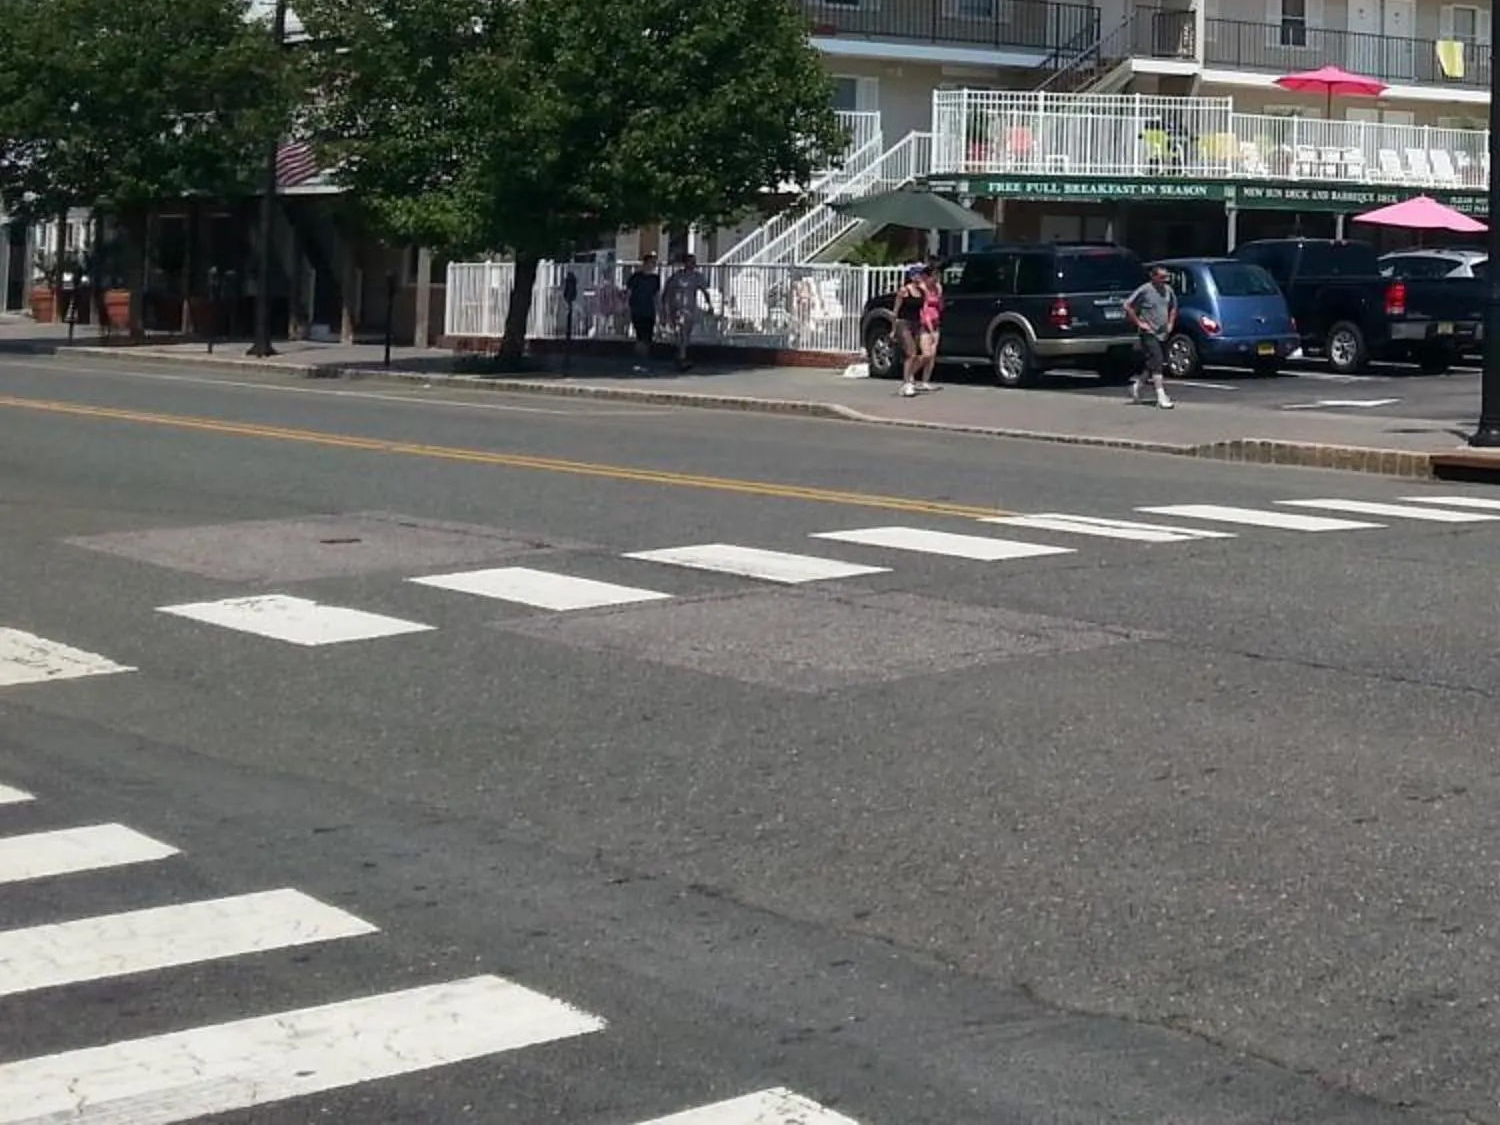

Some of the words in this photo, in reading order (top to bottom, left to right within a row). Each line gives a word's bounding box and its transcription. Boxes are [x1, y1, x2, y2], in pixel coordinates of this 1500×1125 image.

[988, 182, 1021, 193] FREE
[1026, 182, 1061, 194] FULL
[1064, 183, 1137, 195] BREAKFAST
[1141, 184, 1156, 195] IN
[1160, 185, 1208, 196] SEASON
[1243, 187, 1265, 198] NEW
[1285, 189, 1309, 200] DECK
[1312, 190, 1329, 201] AND
